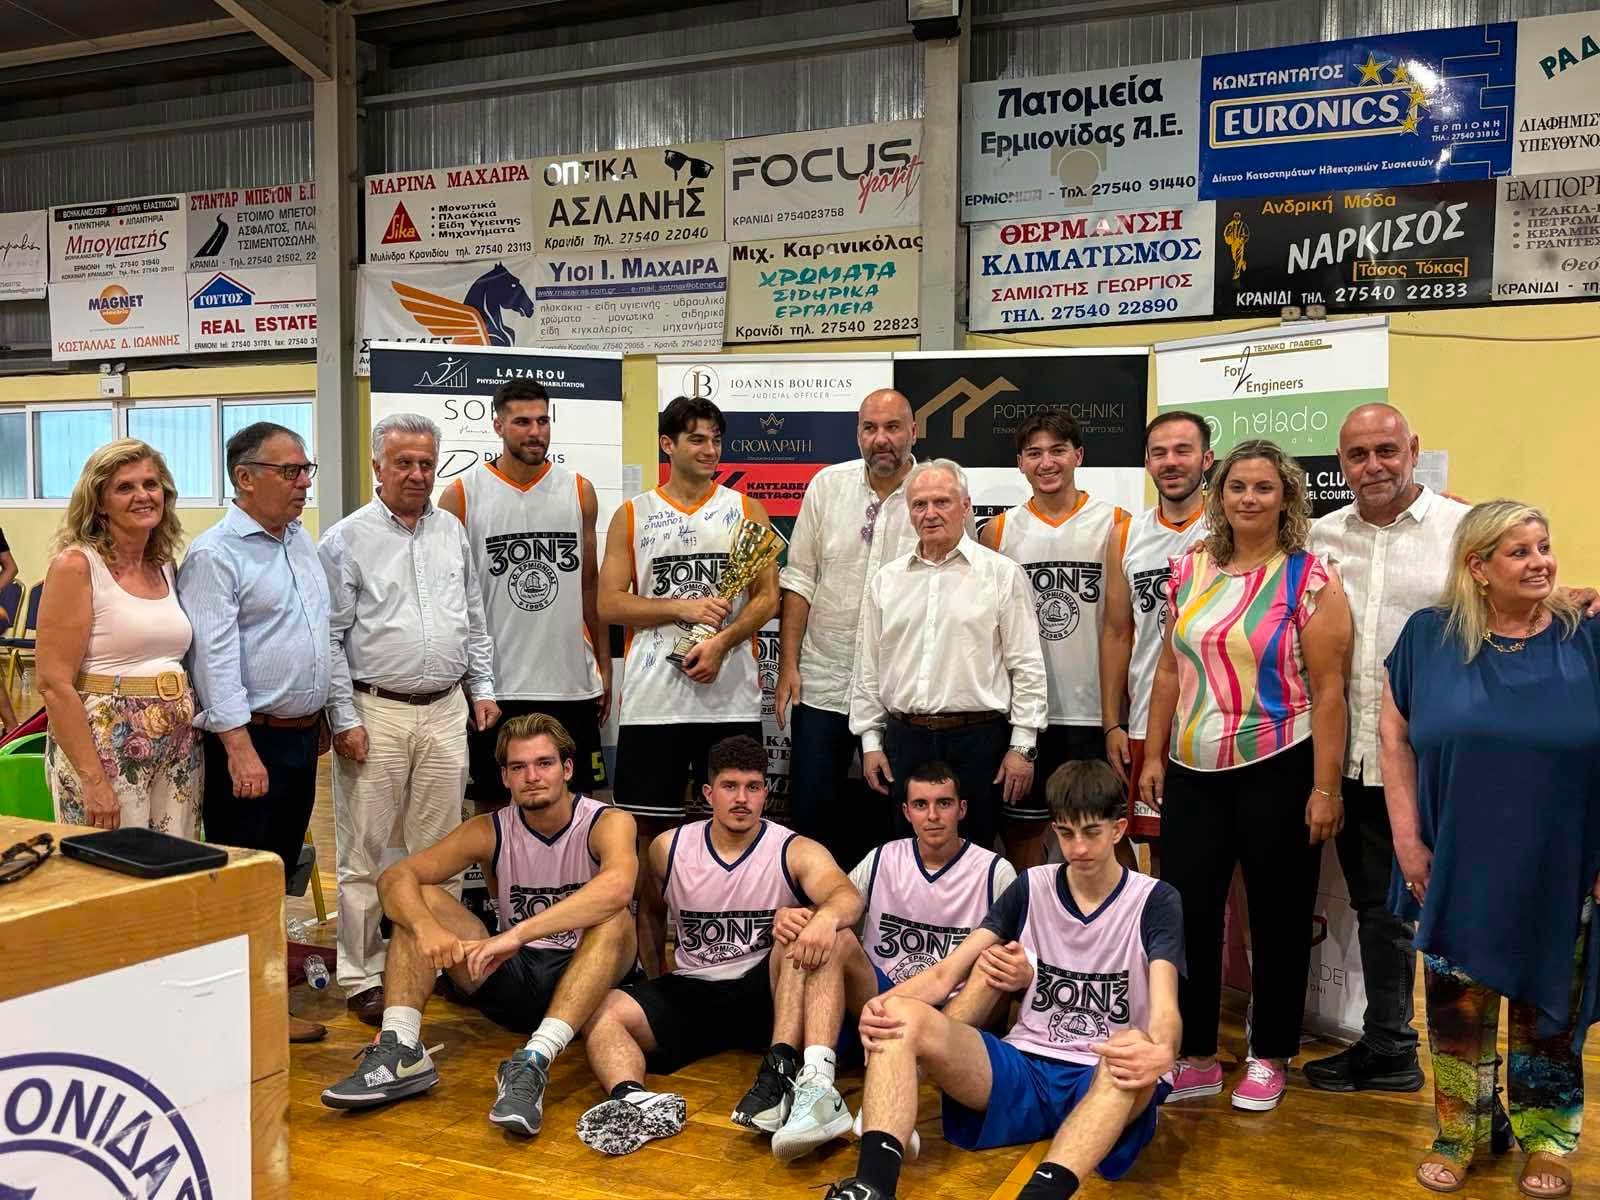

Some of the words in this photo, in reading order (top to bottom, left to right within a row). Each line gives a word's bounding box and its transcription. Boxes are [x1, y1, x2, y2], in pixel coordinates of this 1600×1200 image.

[1212, 64, 1344, 91] ΚΩΝΣΤΑΝΤΑΤΟΣ
[997, 74, 1164, 119] Λατομεία
[1223, 94, 1399, 137] EURONICS
[980, 122, 1125, 158] Ερμιονίδας
[1133, 113, 1183, 140] Α.Ε.
[1452, 131, 1475, 139] 27540
[1519, 134, 1600, 153] ΥΠΕΥΘΥΝΟ
[543, 157, 638, 187] ΟΠΤΙΚΑ
[732, 138, 912, 191] FOCUS
[1212, 172, 1242, 184] Δίκτυο
[1245, 165, 1316, 182] Καταστημάτων
[1319, 161, 1378, 176] Ηλεκτρικών
[1381, 158, 1435, 171] Συσκευών
[370, 175, 436, 196] ΜΑΡΙΝΑ
[447, 165, 530, 189] ΜΑΧΑΙΡΑ
[858, 154, 925, 214] sport
[1060, 186, 1087, 199] Τηλ.
[1091, 180, 1142, 196] 27540
[1149, 176, 1196, 191] 91440
[191, 192, 238, 211] ΣΤΑΝΤΑΡ
[246, 187, 293, 206] ΜΠΕΤΟΝ
[438, 200, 498, 213] Μονωτικά
[548, 187, 706, 228] ΑΣΛΑΝΗΣ
[1262, 195, 1333, 216] Ανδρική
[1344, 192, 1396, 210] Μόδα
[237, 210, 274, 223] ΕΤΟΙΜΟ
[295, 220, 316, 231] ΠΛΑ
[387, 212, 417, 241] Sika
[438, 210, 498, 222] Πλακάκια
[438, 218, 467, 230] Είδη
[732, 215, 773, 226] ΚΡΑΝΙΔΙ
[777, 207, 845, 222] 2754023758
[1000, 209, 1184, 245] ΘΕΡΜΑΝΣΗ
[65, 230, 169, 257] Μπογιατζής
[438, 226, 516, 239] Μηχανήματα
[544, 235, 585, 250] Κρανίδι
[593, 232, 614, 247] Τηλ.
[620, 230, 660, 244] 27540
[665, 227, 708, 241] 22040
[1287, 202, 1468, 274] ΝΑΡΚΙΣΟΣ
[409, 248, 449, 260] Κρανιδίου
[455, 246, 472, 258] τηλ.
[475, 243, 503, 255] 27540
[507, 241, 533, 254] 23113
[733, 246, 774, 264] Μιχ.
[783, 235, 923, 260] Καρανικόλας
[981, 238, 1202, 276] ΚΛΙΜΑΤΙΣΜΟΣ
[120, 260, 139, 269] 27540
[190, 259, 218, 270] ΚΡΑΝΙΔΙ
[248, 255, 273, 266] 27540
[622, 257, 719, 278] ΜΑΧΑΙΡΑ
[1358, 262, 1407, 279] Τάσος
[1416, 260, 1464, 277] Τόκας
[758, 261, 897, 288] ΧΡΩΜΑΤΑ
[199, 292, 243, 306] ΓΟΥΤΟΣ
[992, 281, 1089, 302] ΣΑΜΙΩΤΗΣ
[1097, 273, 1193, 294] ΓΕΩΡΓΙΟΣ
[1236, 290, 1292, 306] ΚΡΑΝΙΔΙ
[1301, 290, 1326, 304] ΤΗΛ.
[1335, 286, 1396, 302] 27540
[1406, 282, 1468, 299] 22833
[1497, 281, 1559, 295] ΚΡΑΝΙΔΙ
[89, 295, 144, 311] MAGNET
[775, 301, 874, 319] ΕΡΓΑΛΕΙΑ
[1001, 310, 1044, 323] ΤΗΛ.
[1051, 303, 1110, 320] 27540
[1118, 298, 1178, 315] 22890
[201, 319, 246, 335] REAL
[255, 315, 317, 332] ESTATE
[736, 323, 783, 338] Κρανίδι
[790, 324, 814, 337] τηλ.
[821, 320, 865, 334] 27540
[873, 317, 919, 331] 22823
[58, 338, 116, 353] ΚΩΣΤΑΛΛΑΣ
[121, 339, 131, 349] Δ.
[134, 335, 180, 348] ΙΩΑΝΝΗΣ
[231, 340, 251, 349] 27540
[288, 338, 308, 347] 27540
[1253, 342, 1286, 352] ΤΕΧΝΙΚΟ
[1289, 338, 1322, 349] ΓΡΑΦΕΙΟ
[497, 368, 565, 380] LAZAROU
[1224, 365, 1243, 378] For
[730, 379, 784, 389] IOANNIS
[789, 378, 853, 388] BOURICAS
[1246, 378, 1304, 395] Engineers
[1233, 406, 1328, 435] helado
[1320, 490, 1356, 500] COURTS
[486, 539, 580, 577] 3ON3
[1027, 568, 1102, 604] ON3
[681, 918, 775, 952] 3ON3
[1031, 973, 1129, 1024] 3ON3
